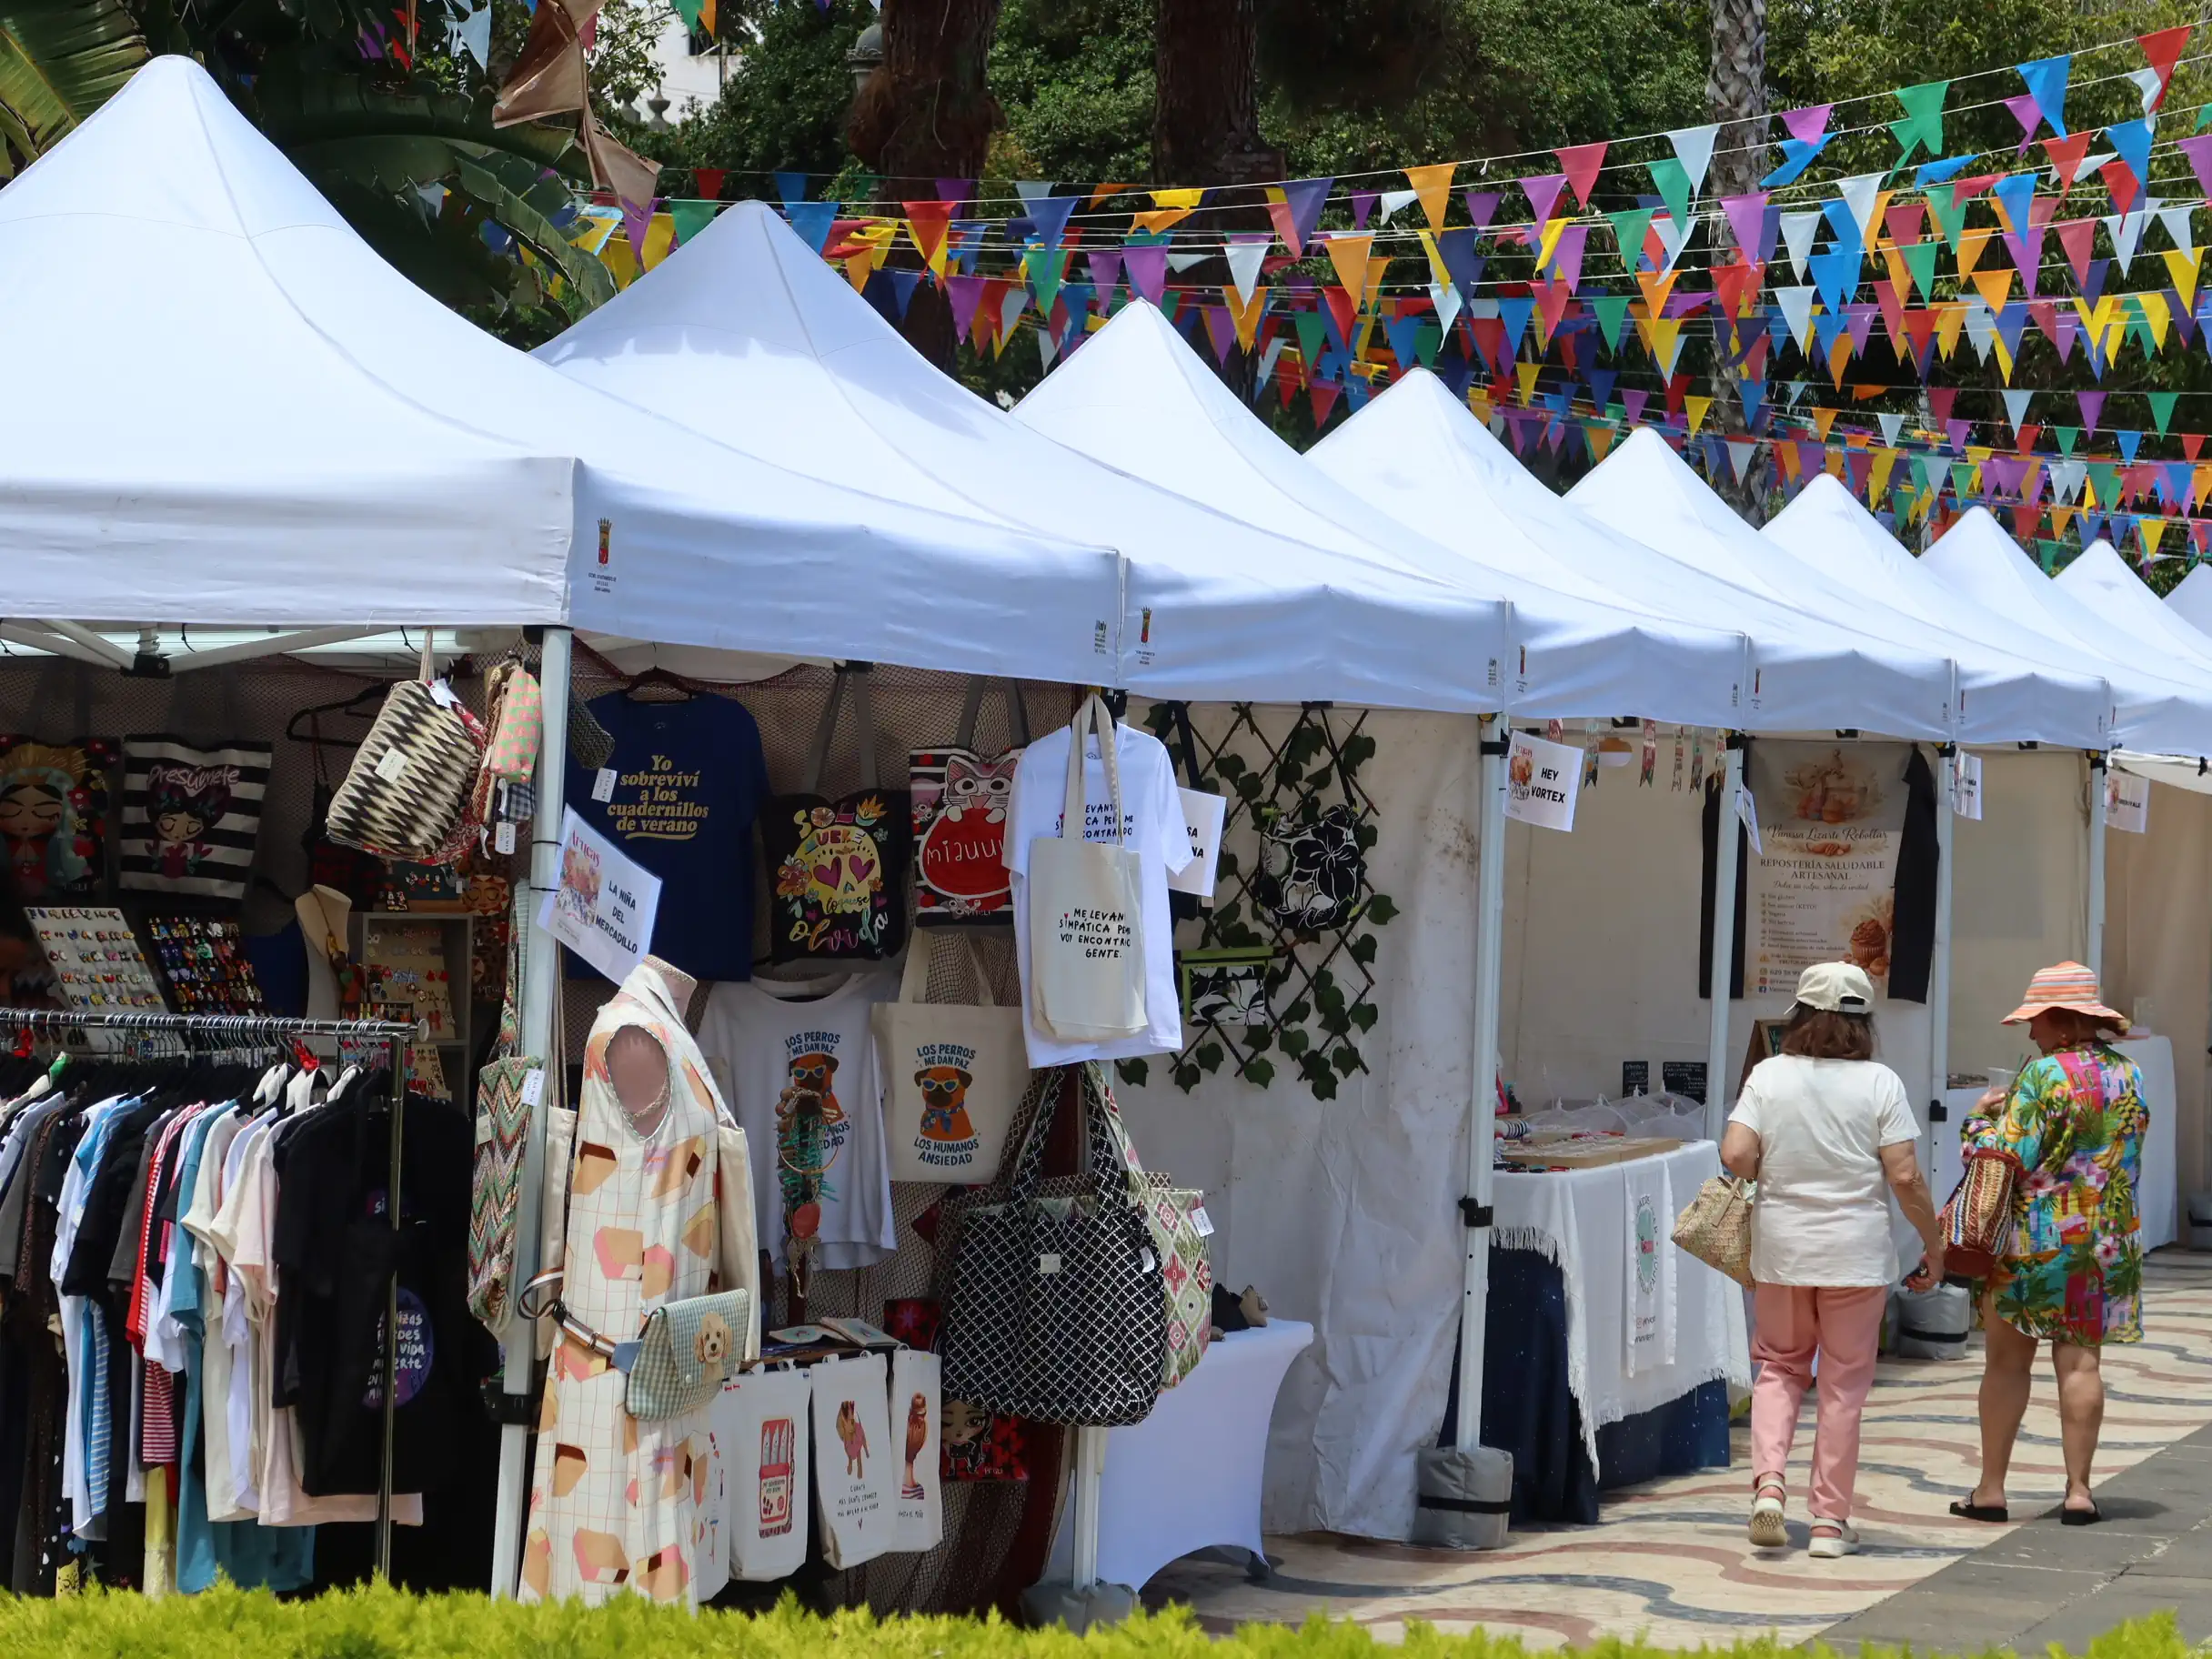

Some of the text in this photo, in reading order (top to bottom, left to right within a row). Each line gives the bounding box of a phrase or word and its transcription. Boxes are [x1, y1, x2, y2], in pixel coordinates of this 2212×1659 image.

[651, 755, 673, 771] Yo
[620, 770, 700, 787] sobreviví
[1541, 768, 1559, 781] HEY
[639, 786, 678, 801] a los
[1531, 786, 1566, 803] VORTEX
[607, 801, 709, 818] cuadernillos
[616, 818, 698, 833] de verano
[1760, 858, 1885, 870] REPOSTERÍA SALUDABLE
[1791, 871, 1851, 880] ARTESANAL
[608, 880, 636, 911] LA NIÑA
[612, 906, 625, 924] DEL
[1073, 908, 1126, 921] ME LEVAN
[596, 916, 638, 954] MERCADILLO
[1061, 933, 1073, 942] VOY
[1085, 949, 1122, 959] GENTE.
[785, 1031, 840, 1049] LOS PERROS
[792, 1042, 835, 1055] ME DAN PAZ
[917, 1044, 976, 1060] LOS PERROS
[924, 1055, 970, 1070] ME DAN PAZ
[914, 1136, 979, 1153] LOS HUMANOS
[918, 1151, 972, 1166] ANSIEDAD
